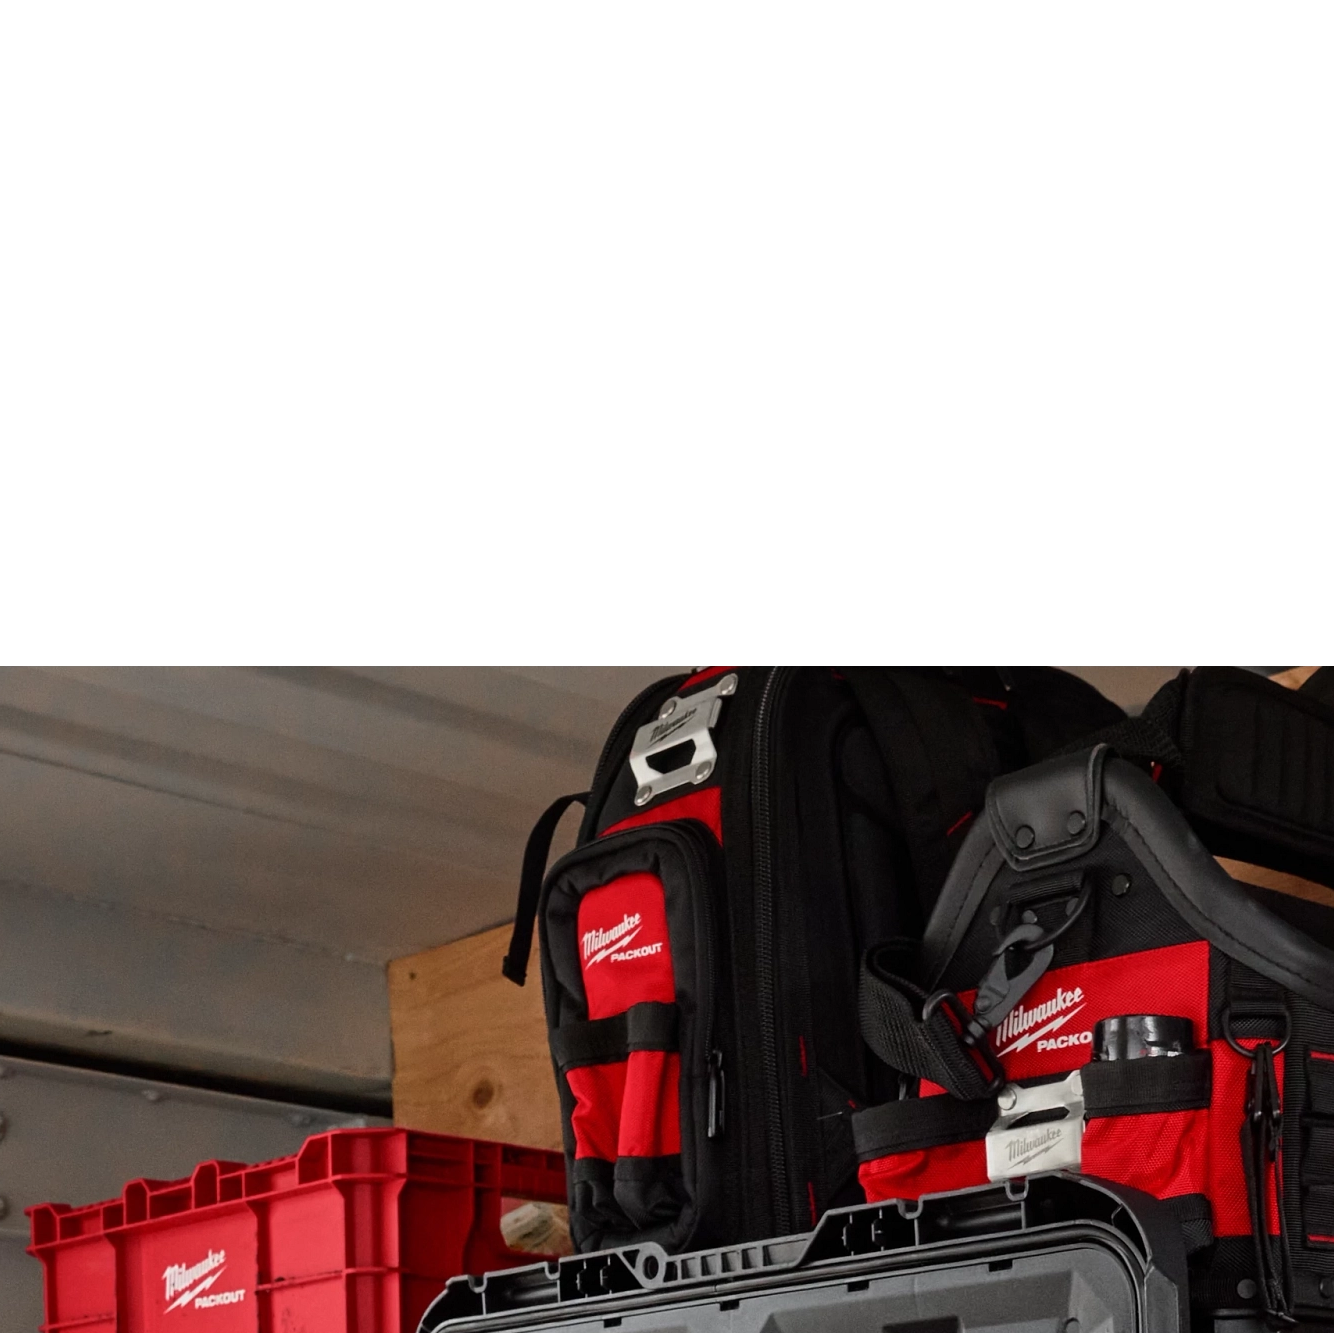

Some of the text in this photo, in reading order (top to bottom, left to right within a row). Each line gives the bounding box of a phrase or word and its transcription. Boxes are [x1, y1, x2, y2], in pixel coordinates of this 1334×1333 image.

[581, 912, 642, 960] Milwaukee
[610, 942, 664, 963] PACKOUT
[1037, 1031, 1093, 1053] PACKO
[1005, 1128, 1063, 1162] Milwaukee
[161, 1249, 227, 1302] Milwaukee
[194, 1288, 246, 1310] PACKOUT
